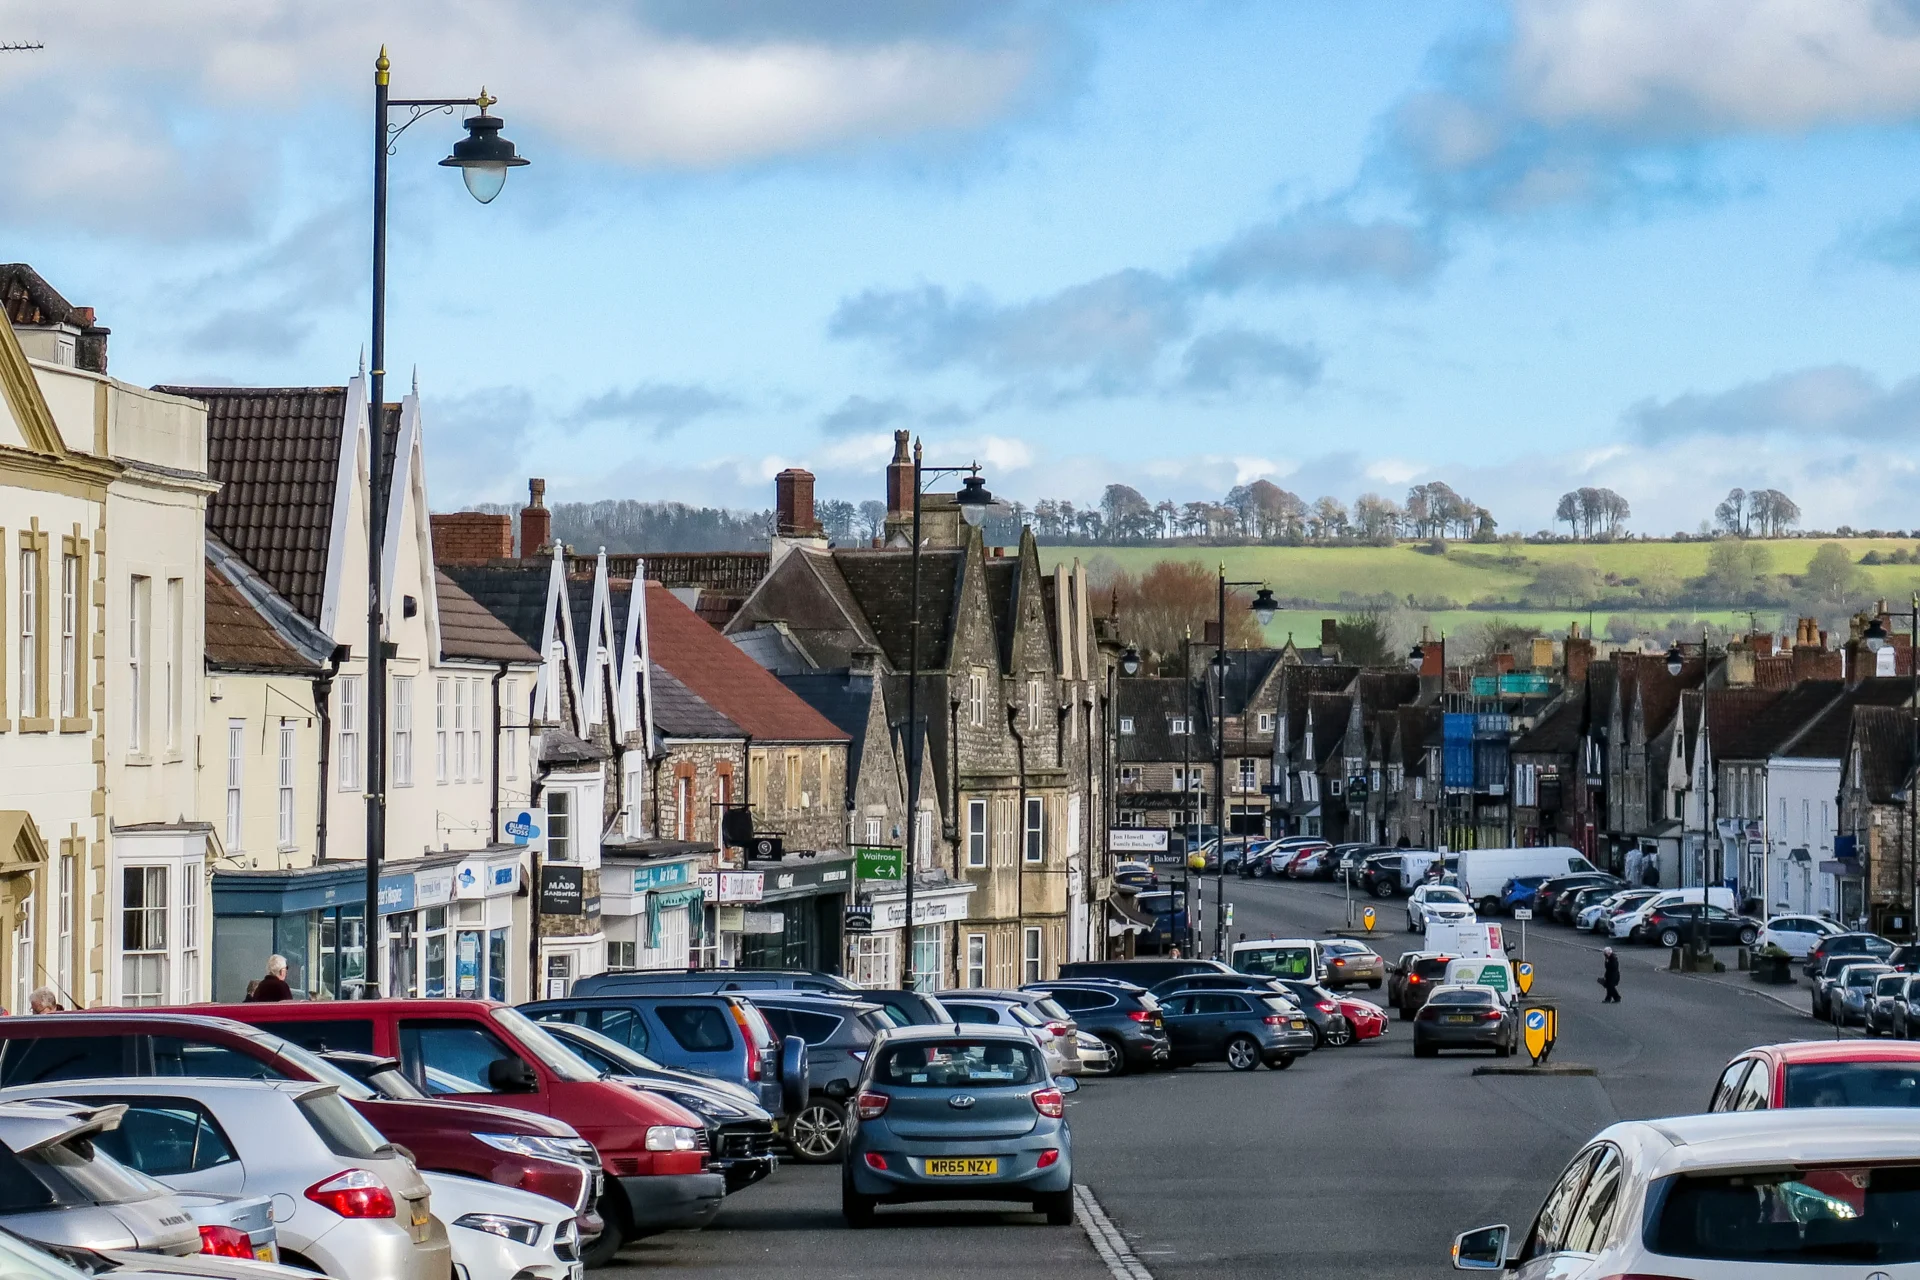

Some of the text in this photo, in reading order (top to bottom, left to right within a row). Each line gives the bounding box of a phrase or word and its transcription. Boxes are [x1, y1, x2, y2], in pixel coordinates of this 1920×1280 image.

[508, 828, 529, 837] CROSS
[862, 852, 896, 861] Waitrose
[1154, 855, 1181, 864] Bakery
[548, 882, 575, 890] MADD
[932, 1160, 993, 1173] WR65 NZY
